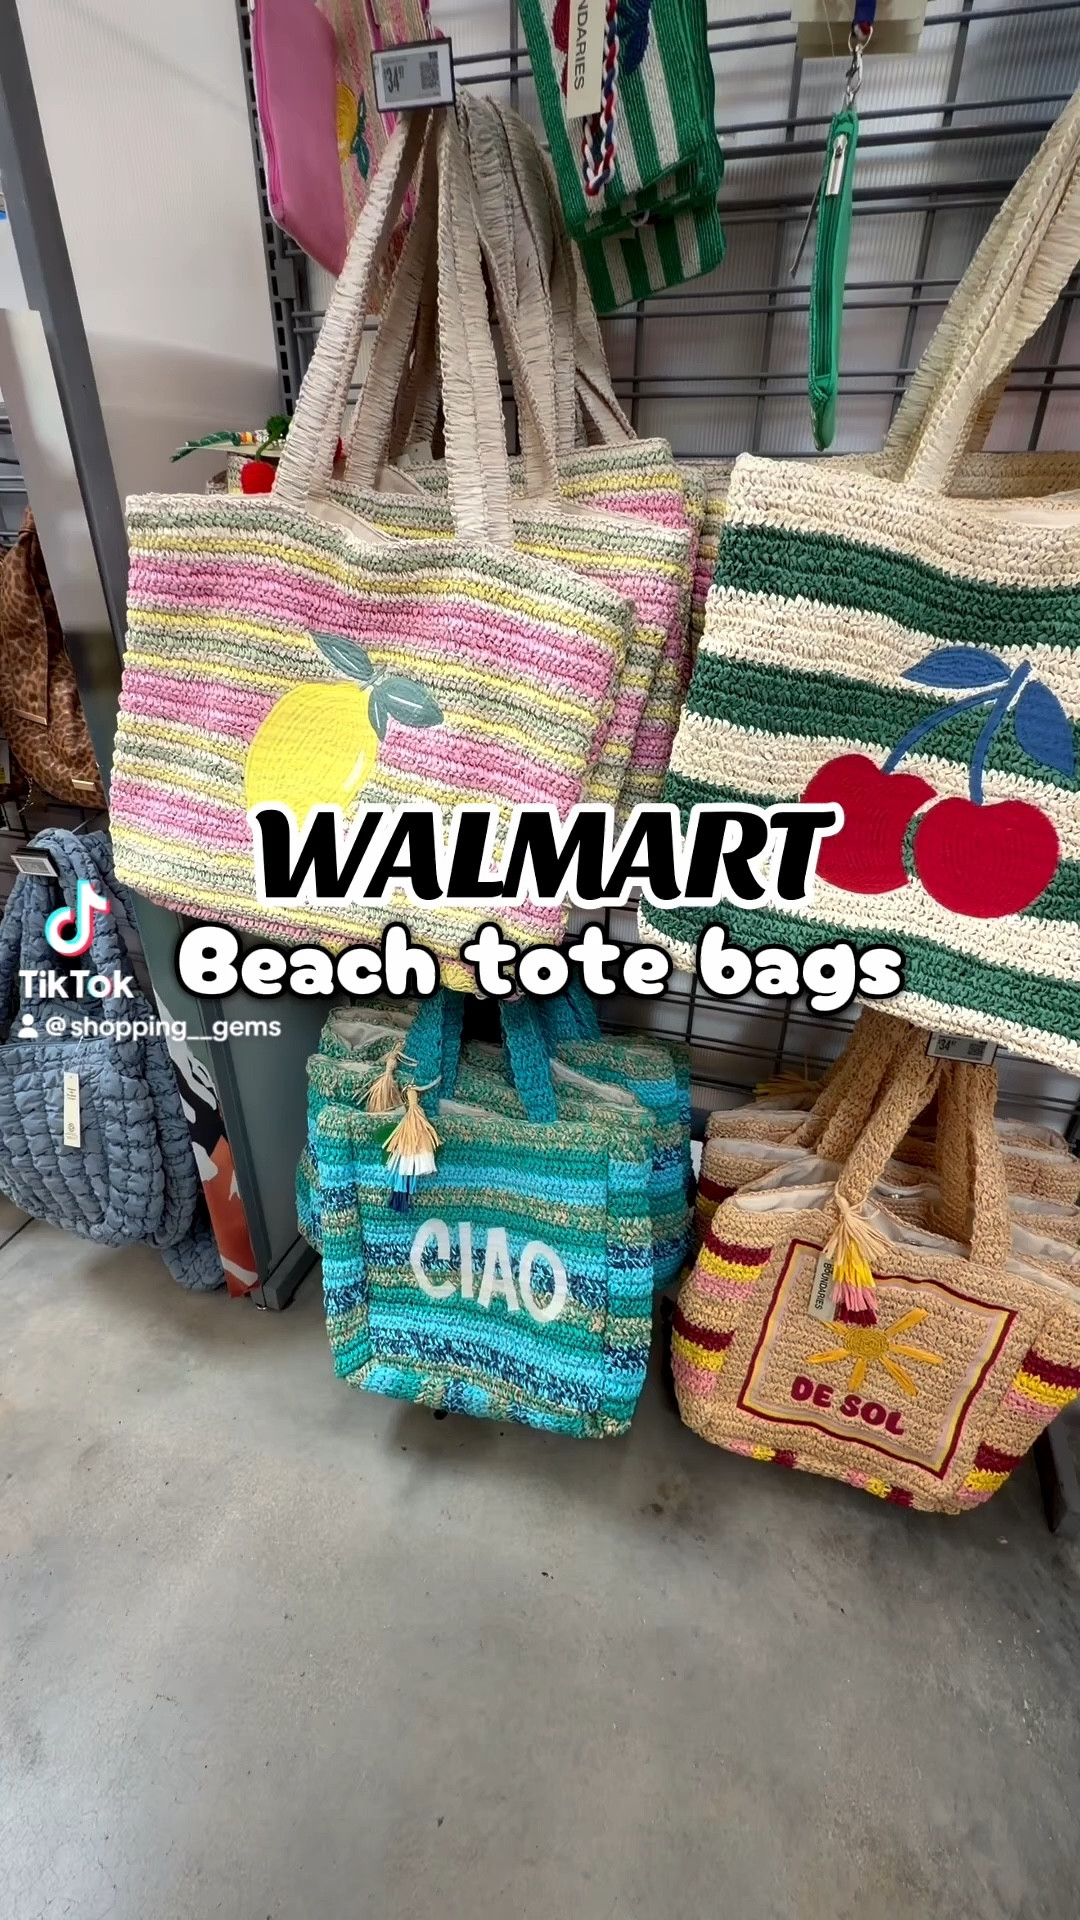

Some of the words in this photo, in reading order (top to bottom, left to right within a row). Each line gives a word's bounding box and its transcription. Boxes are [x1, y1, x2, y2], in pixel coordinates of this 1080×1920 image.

[410, 1218, 568, 1322] CIAO
[814, 1262, 832, 1310] BOUNDARIES
[791, 1375, 834, 1408] DE
[840, 1394, 904, 1436] SOL
